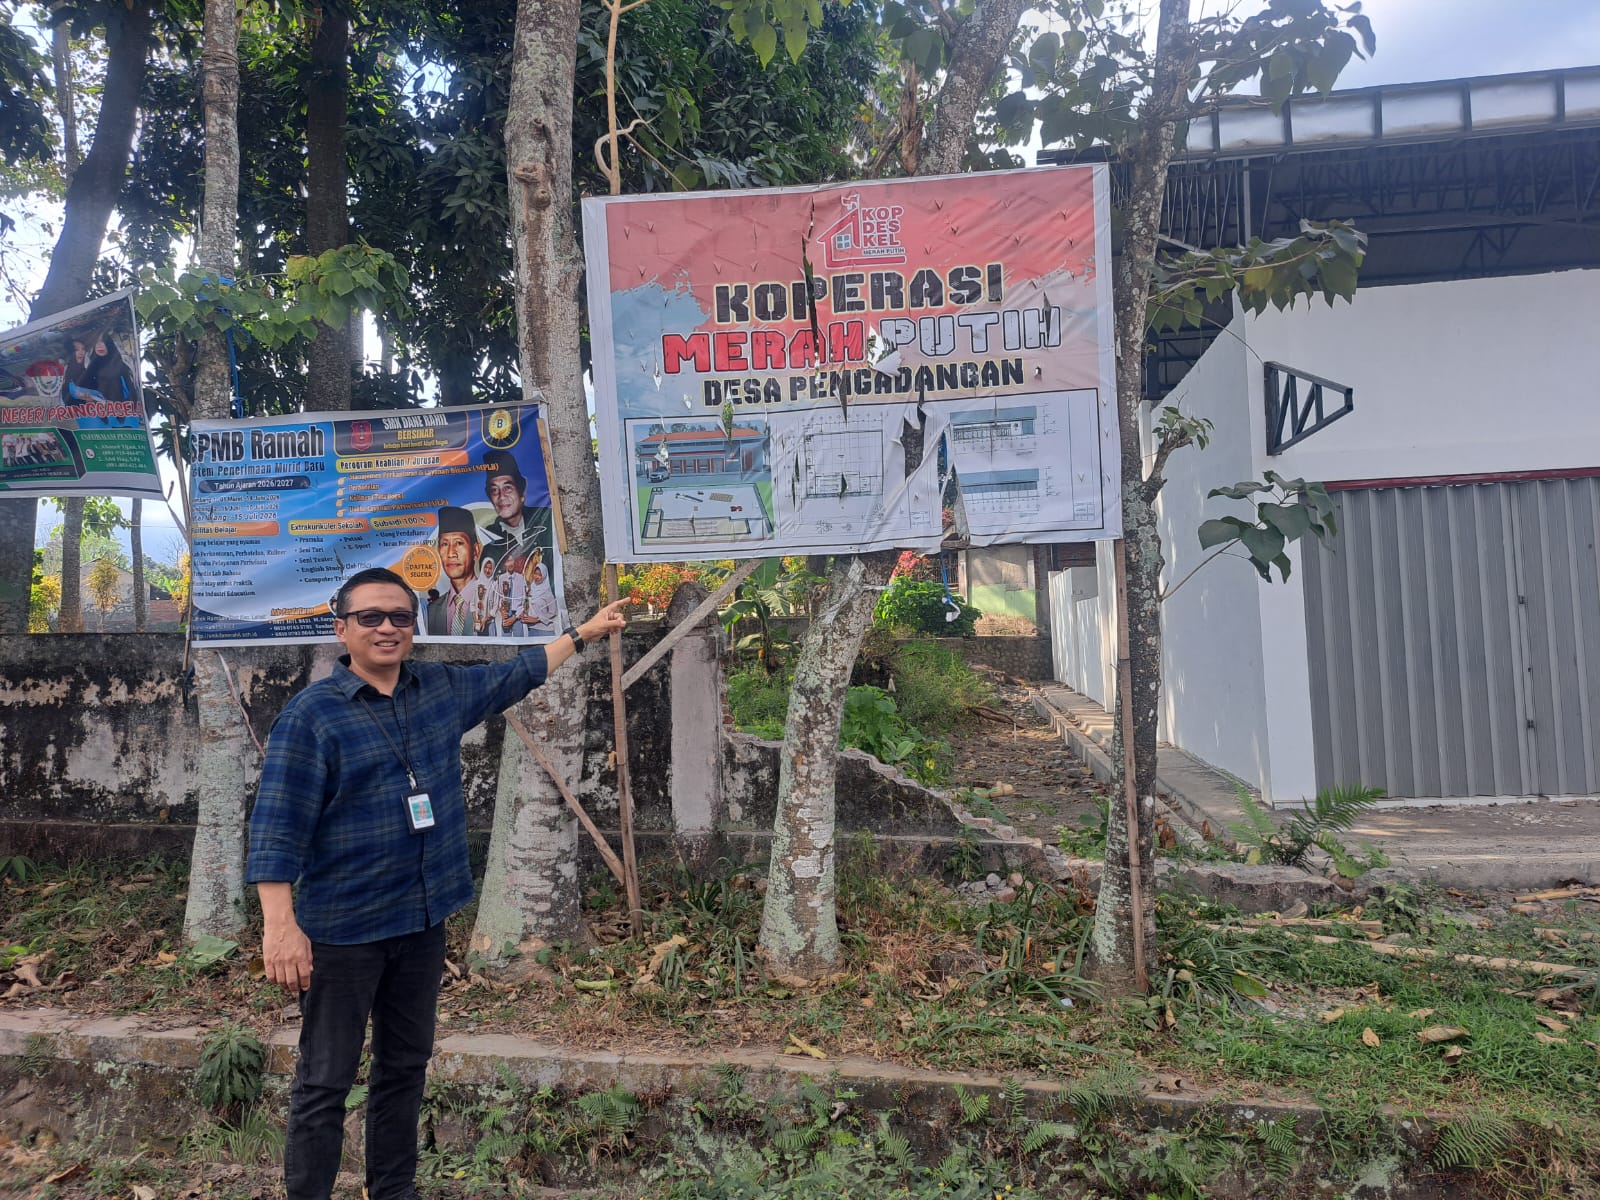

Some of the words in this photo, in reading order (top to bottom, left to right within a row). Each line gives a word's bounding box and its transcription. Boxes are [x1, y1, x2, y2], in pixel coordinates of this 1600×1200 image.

[862, 207, 903, 221] KOP
[862, 221, 900, 234] DES
[863, 234, 900, 247] KEL
[714, 263, 1004, 323] KOPERASI
[661, 320, 865, 374] MERAH
[878, 305, 1060, 358] PUTIH
[702, 374, 781, 407] DESA
[789, 358, 1024, 402] PENGADANGAN
[1, 408, 46, 424] NEGERI
[382, 416, 402, 431] SMK
[497, 419, 503, 428] B
[250, 425, 325, 461] Ramah
[218, 464, 272, 476] Penerimaan
[275, 462, 301, 473] Murid
[304, 460, 325, 472] Baru
[375, 457, 405, 468] Keahlian
[412, 456, 440, 465] Jurusan
[214, 482, 235, 490] Tahun
[236, 481, 257, 491] Ajaran
[257, 479, 294, 488] 2026/2027
[337, 522, 364, 530] Sekolah
